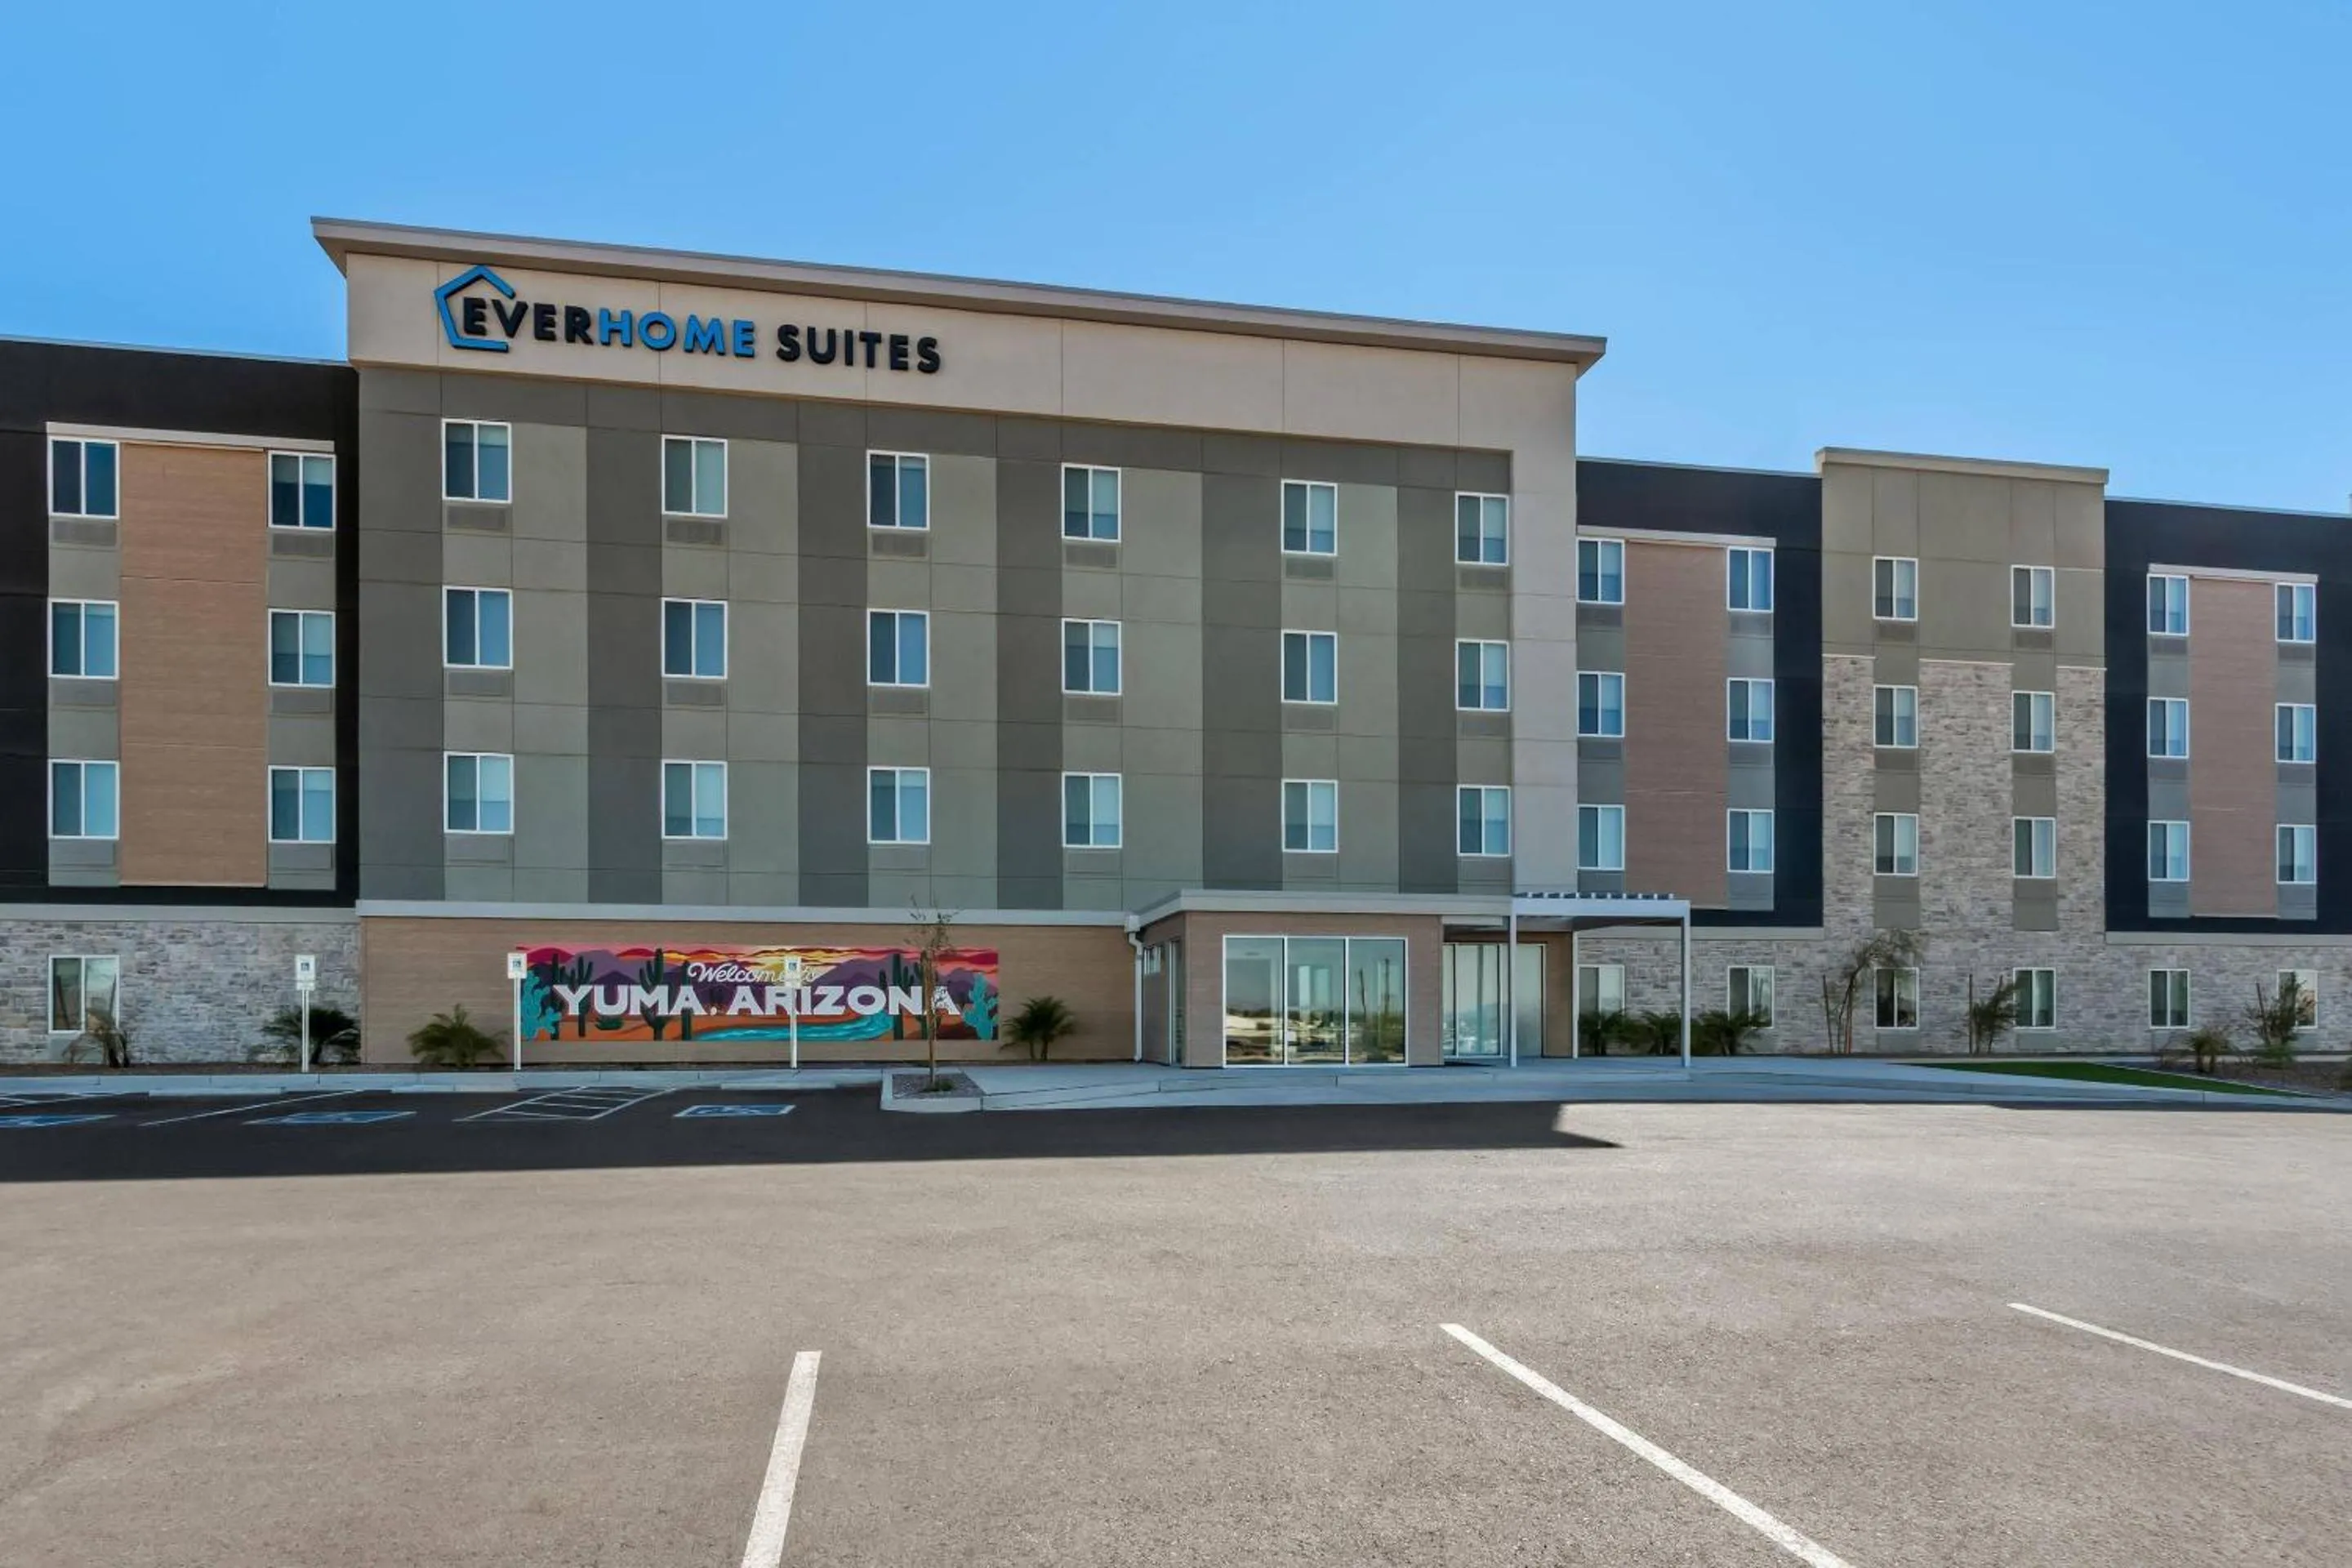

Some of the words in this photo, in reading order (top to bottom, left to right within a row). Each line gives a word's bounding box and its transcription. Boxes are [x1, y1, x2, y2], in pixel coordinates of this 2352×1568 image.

[463, 296, 755, 358] EVERHOME
[776, 324, 941, 374] SUITES
[725, 985, 961, 1015] ARIZONA
